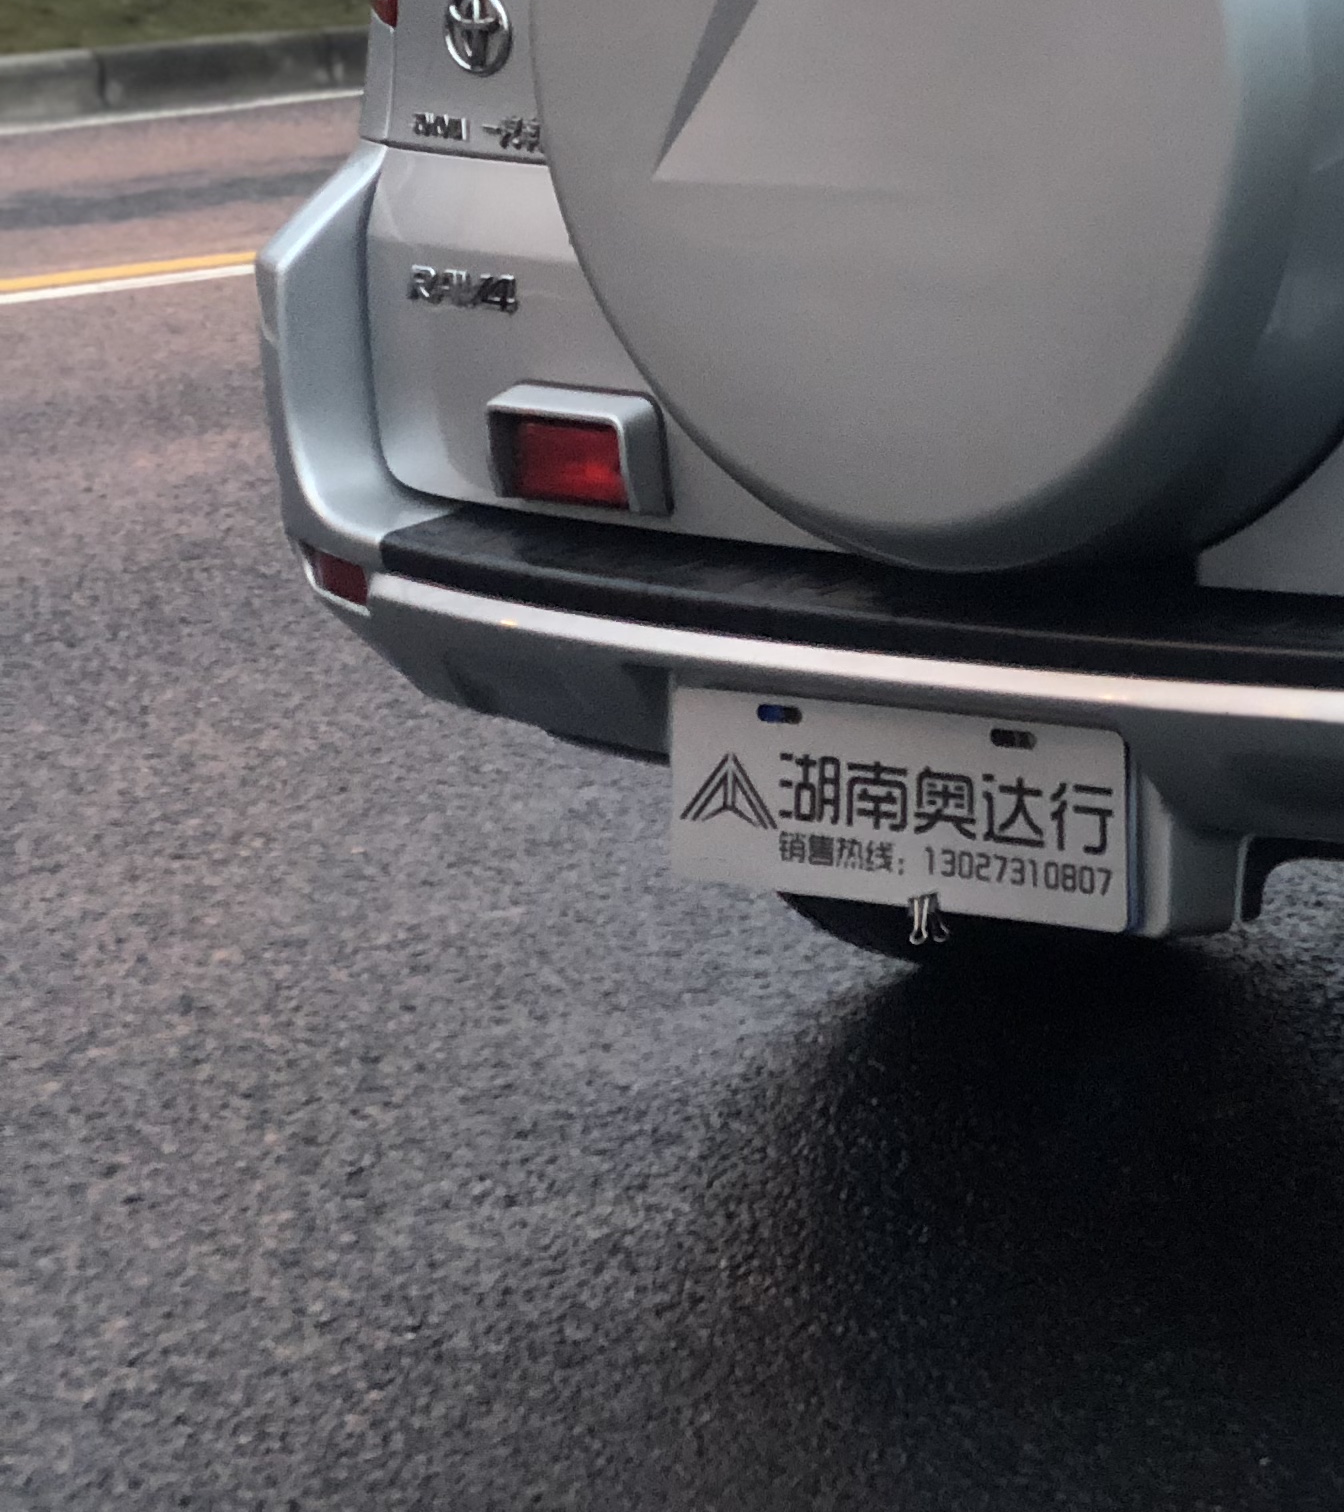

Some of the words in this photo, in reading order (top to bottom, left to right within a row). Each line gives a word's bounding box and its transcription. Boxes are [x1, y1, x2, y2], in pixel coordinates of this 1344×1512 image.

[778, 751, 1114, 855] 湖南奥达行
[923, 846, 1113, 896] 13027310807
